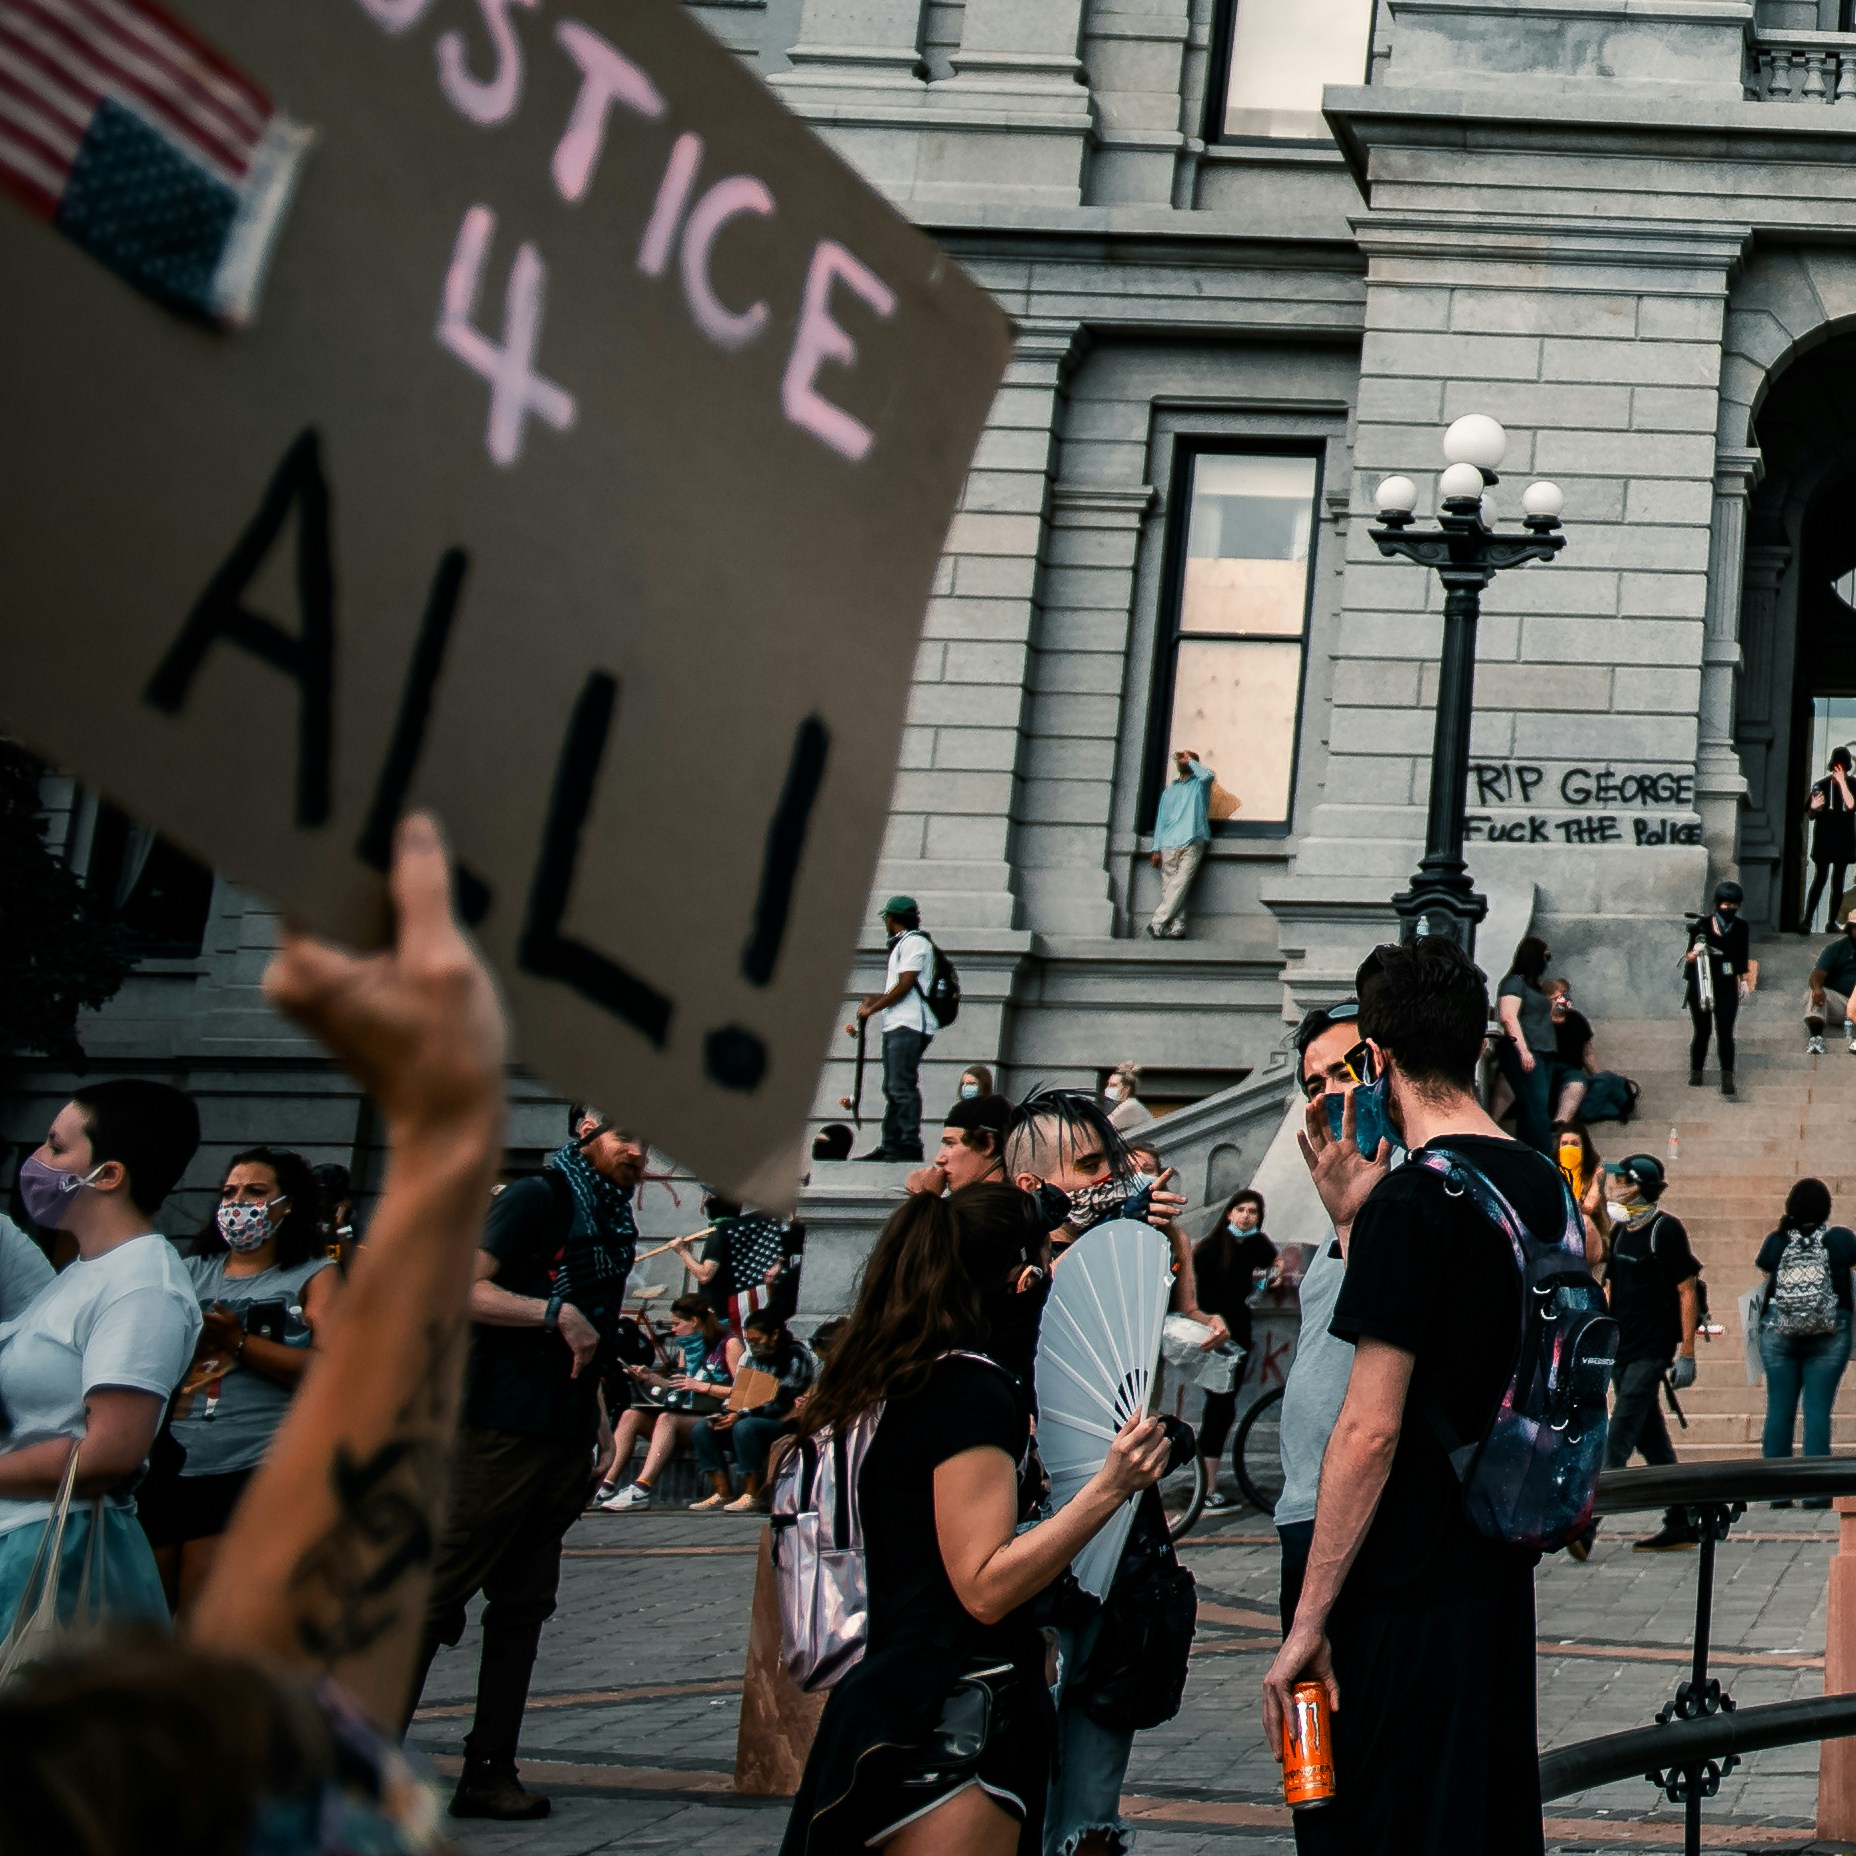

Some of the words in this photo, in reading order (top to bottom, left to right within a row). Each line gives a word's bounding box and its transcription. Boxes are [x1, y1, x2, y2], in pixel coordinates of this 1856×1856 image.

[437, 202, 578, 465] 4
[139, 424, 834, 1099] ALL!
[1466, 763, 1543, 806] RIP
[1560, 766, 1695, 806] GEORGE
[1554, 815, 1622, 843] THE
